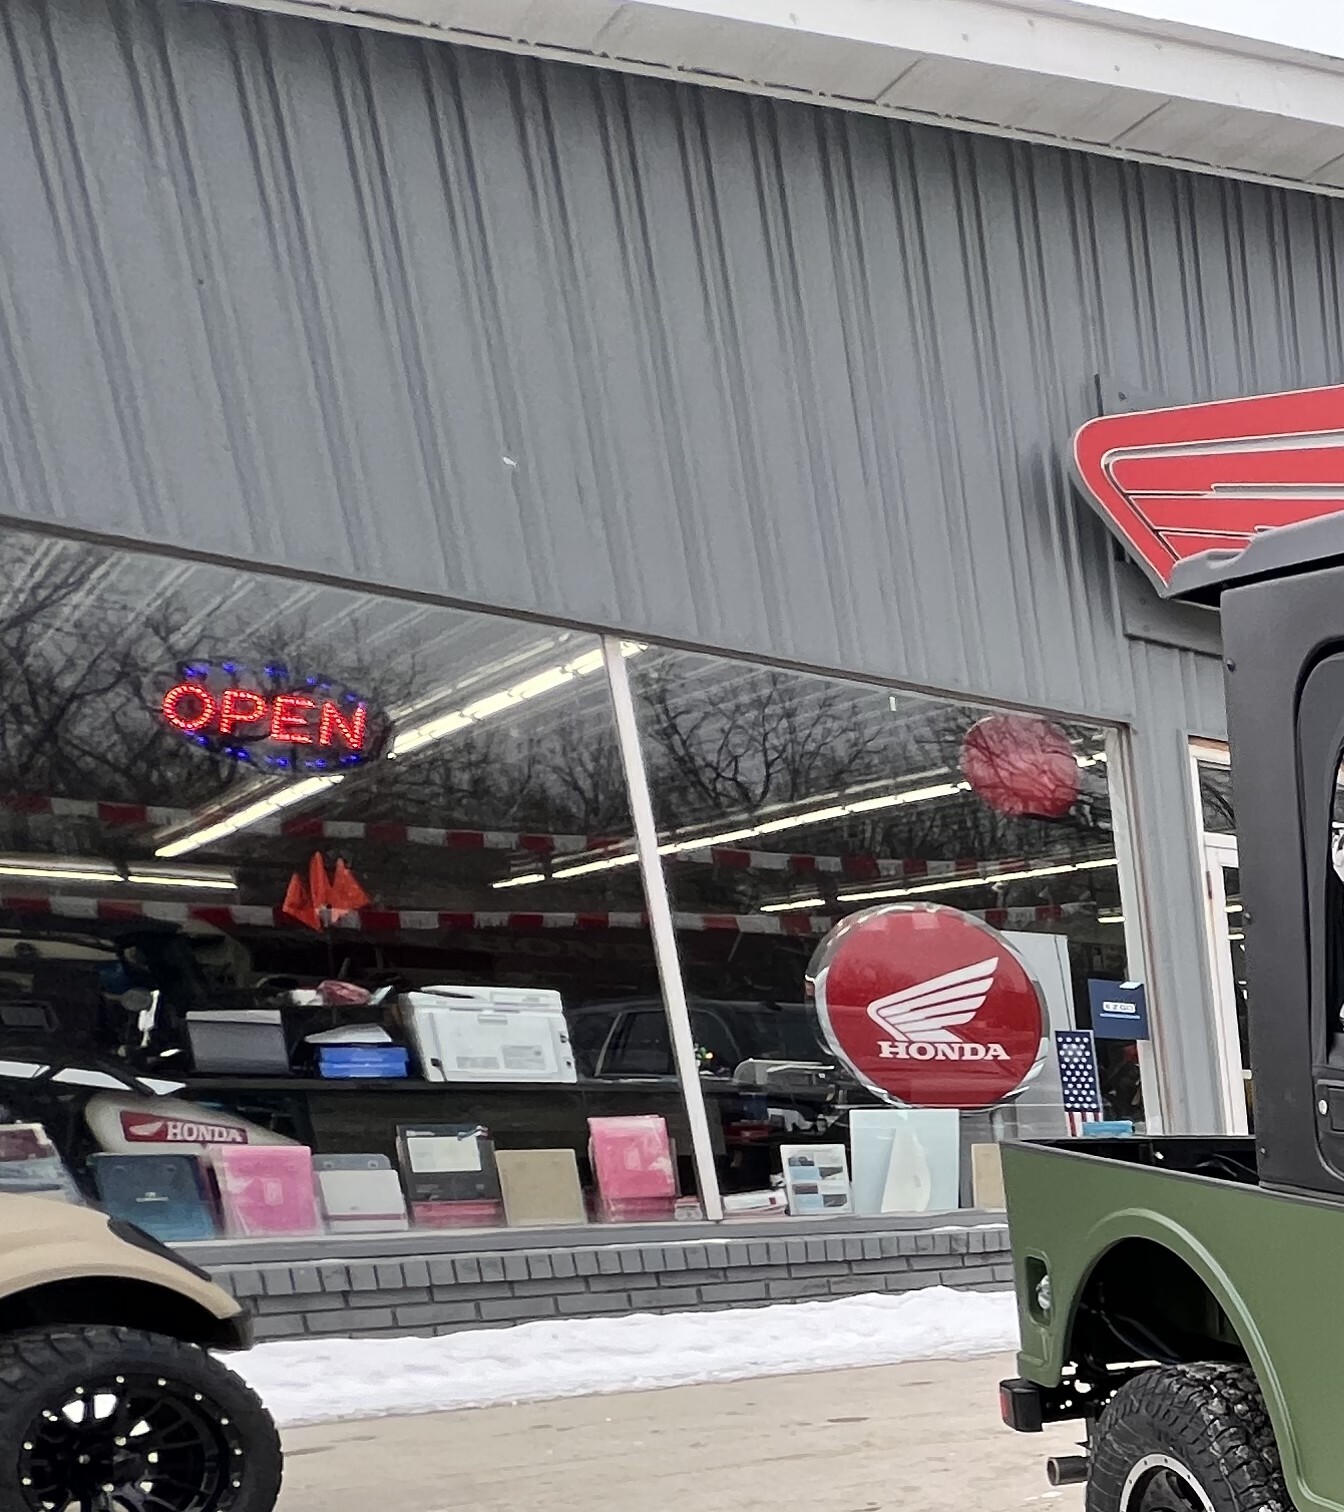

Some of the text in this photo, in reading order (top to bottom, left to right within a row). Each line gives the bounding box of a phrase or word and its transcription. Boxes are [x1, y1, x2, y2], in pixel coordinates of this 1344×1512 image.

[162, 683, 367, 750] OPEN
[877, 1041, 1011, 1060] HONDA
[166, 1121, 243, 1142] HONDA
